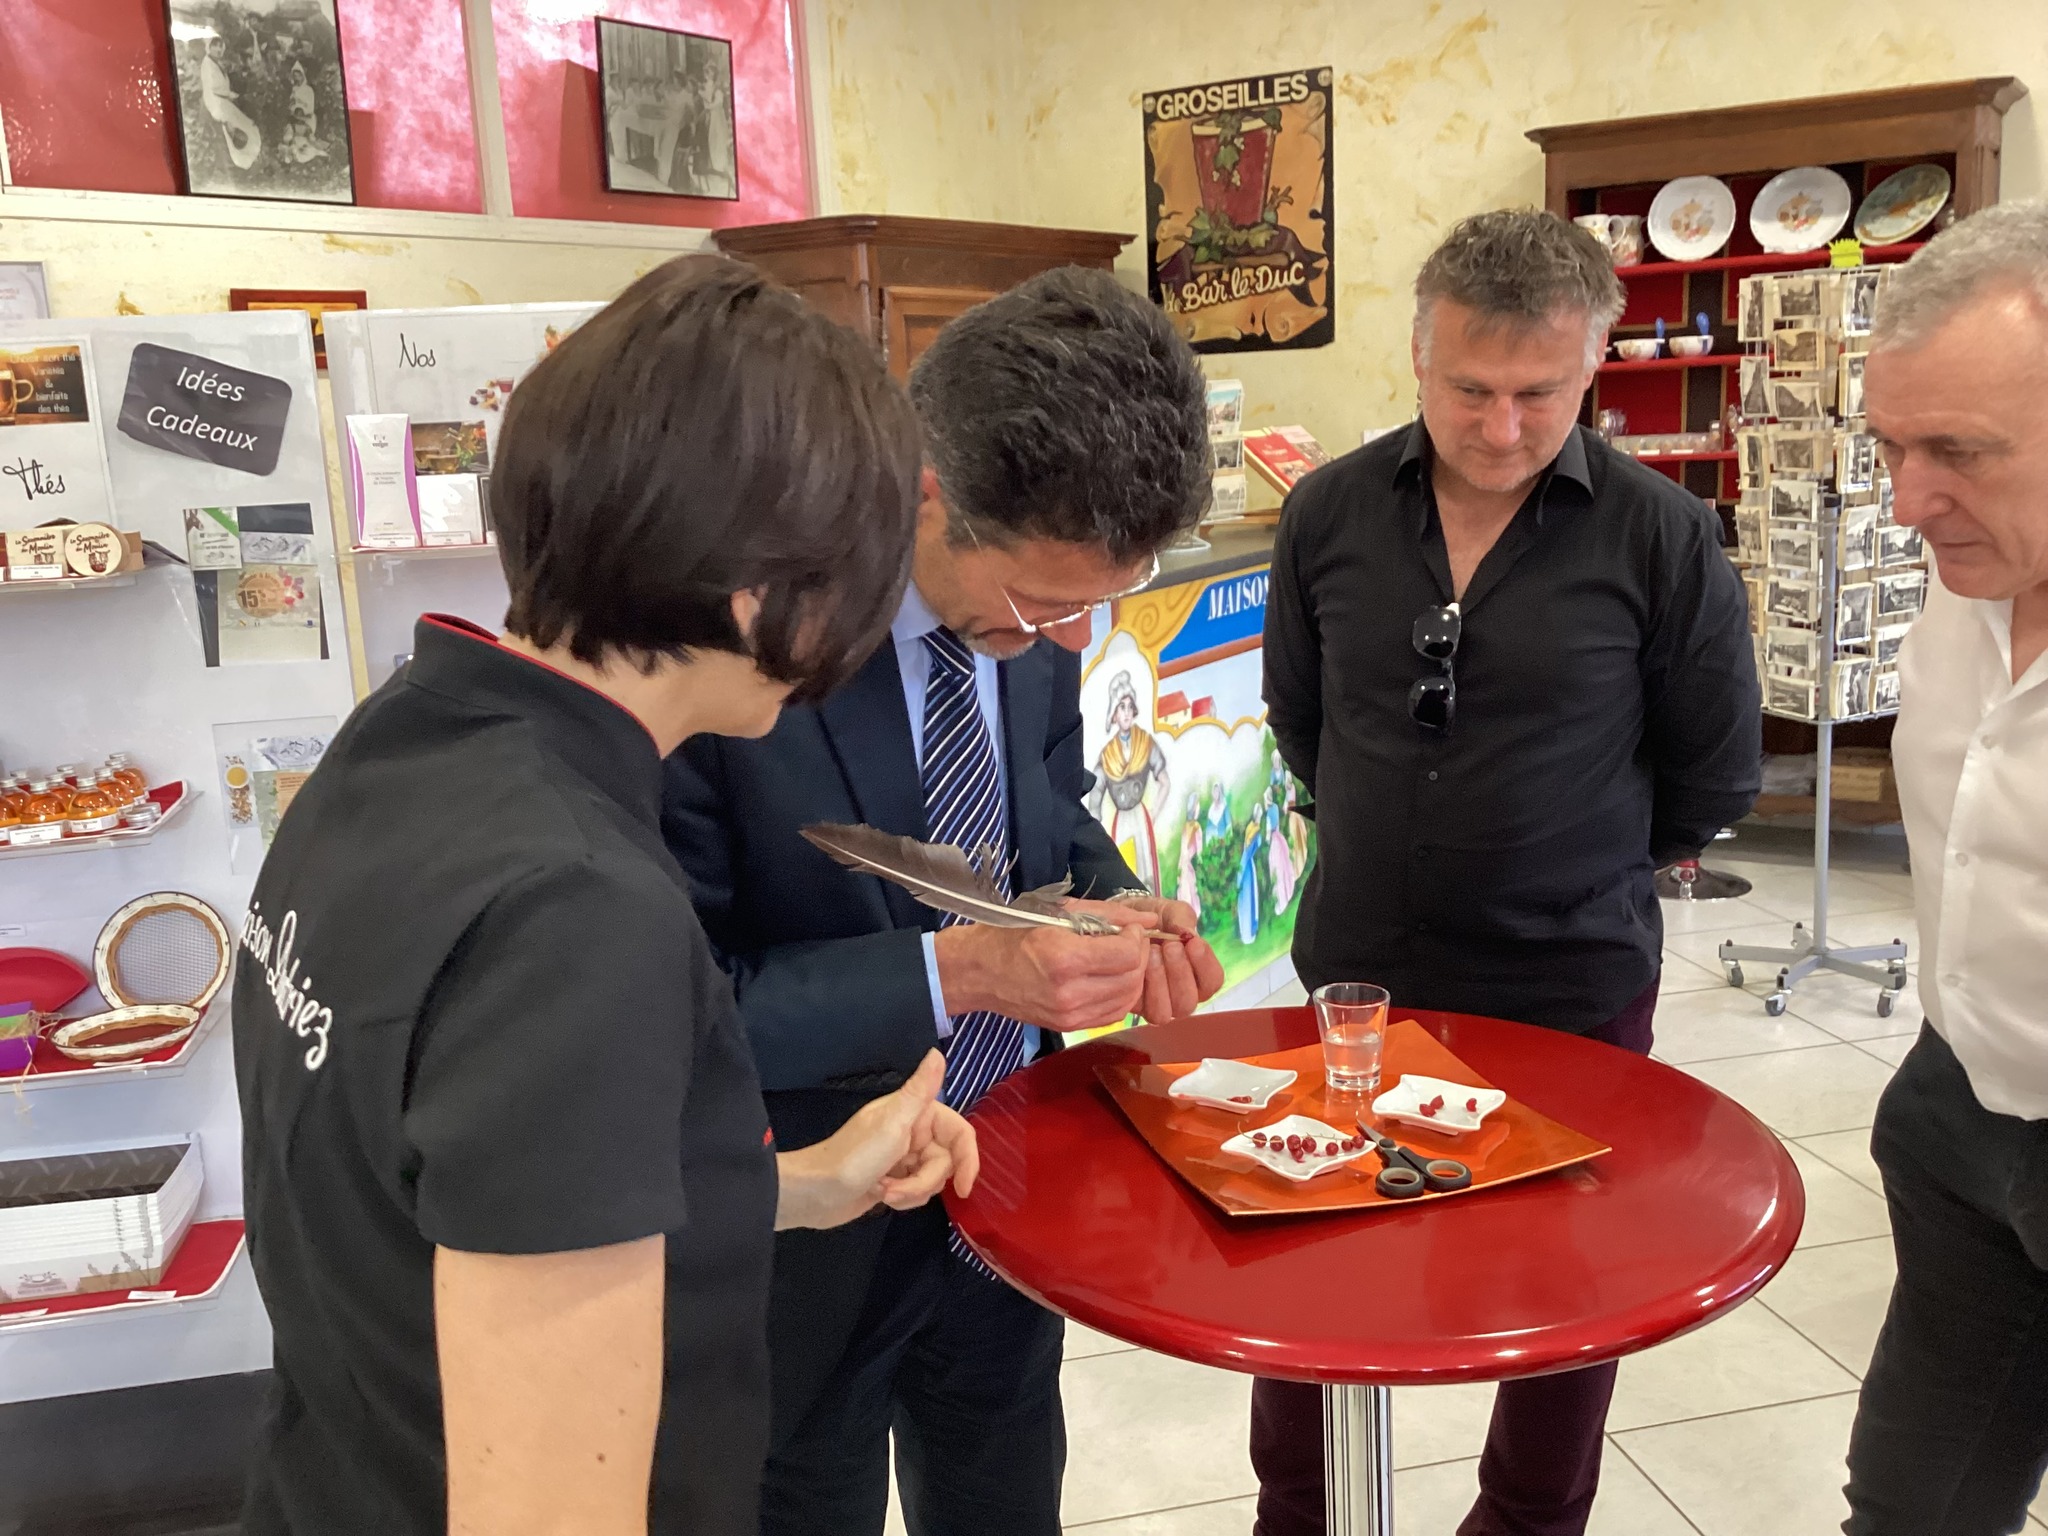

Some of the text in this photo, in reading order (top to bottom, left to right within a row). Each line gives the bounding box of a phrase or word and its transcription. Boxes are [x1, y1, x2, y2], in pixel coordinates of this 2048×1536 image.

[1156, 74, 1309, 120] GROSEILLES
[399, 333, 436, 368] Nos
[176, 367, 245, 402] Idées
[146, 406, 258, 451] Cadeaux
[2, 457, 65, 500] Thés
